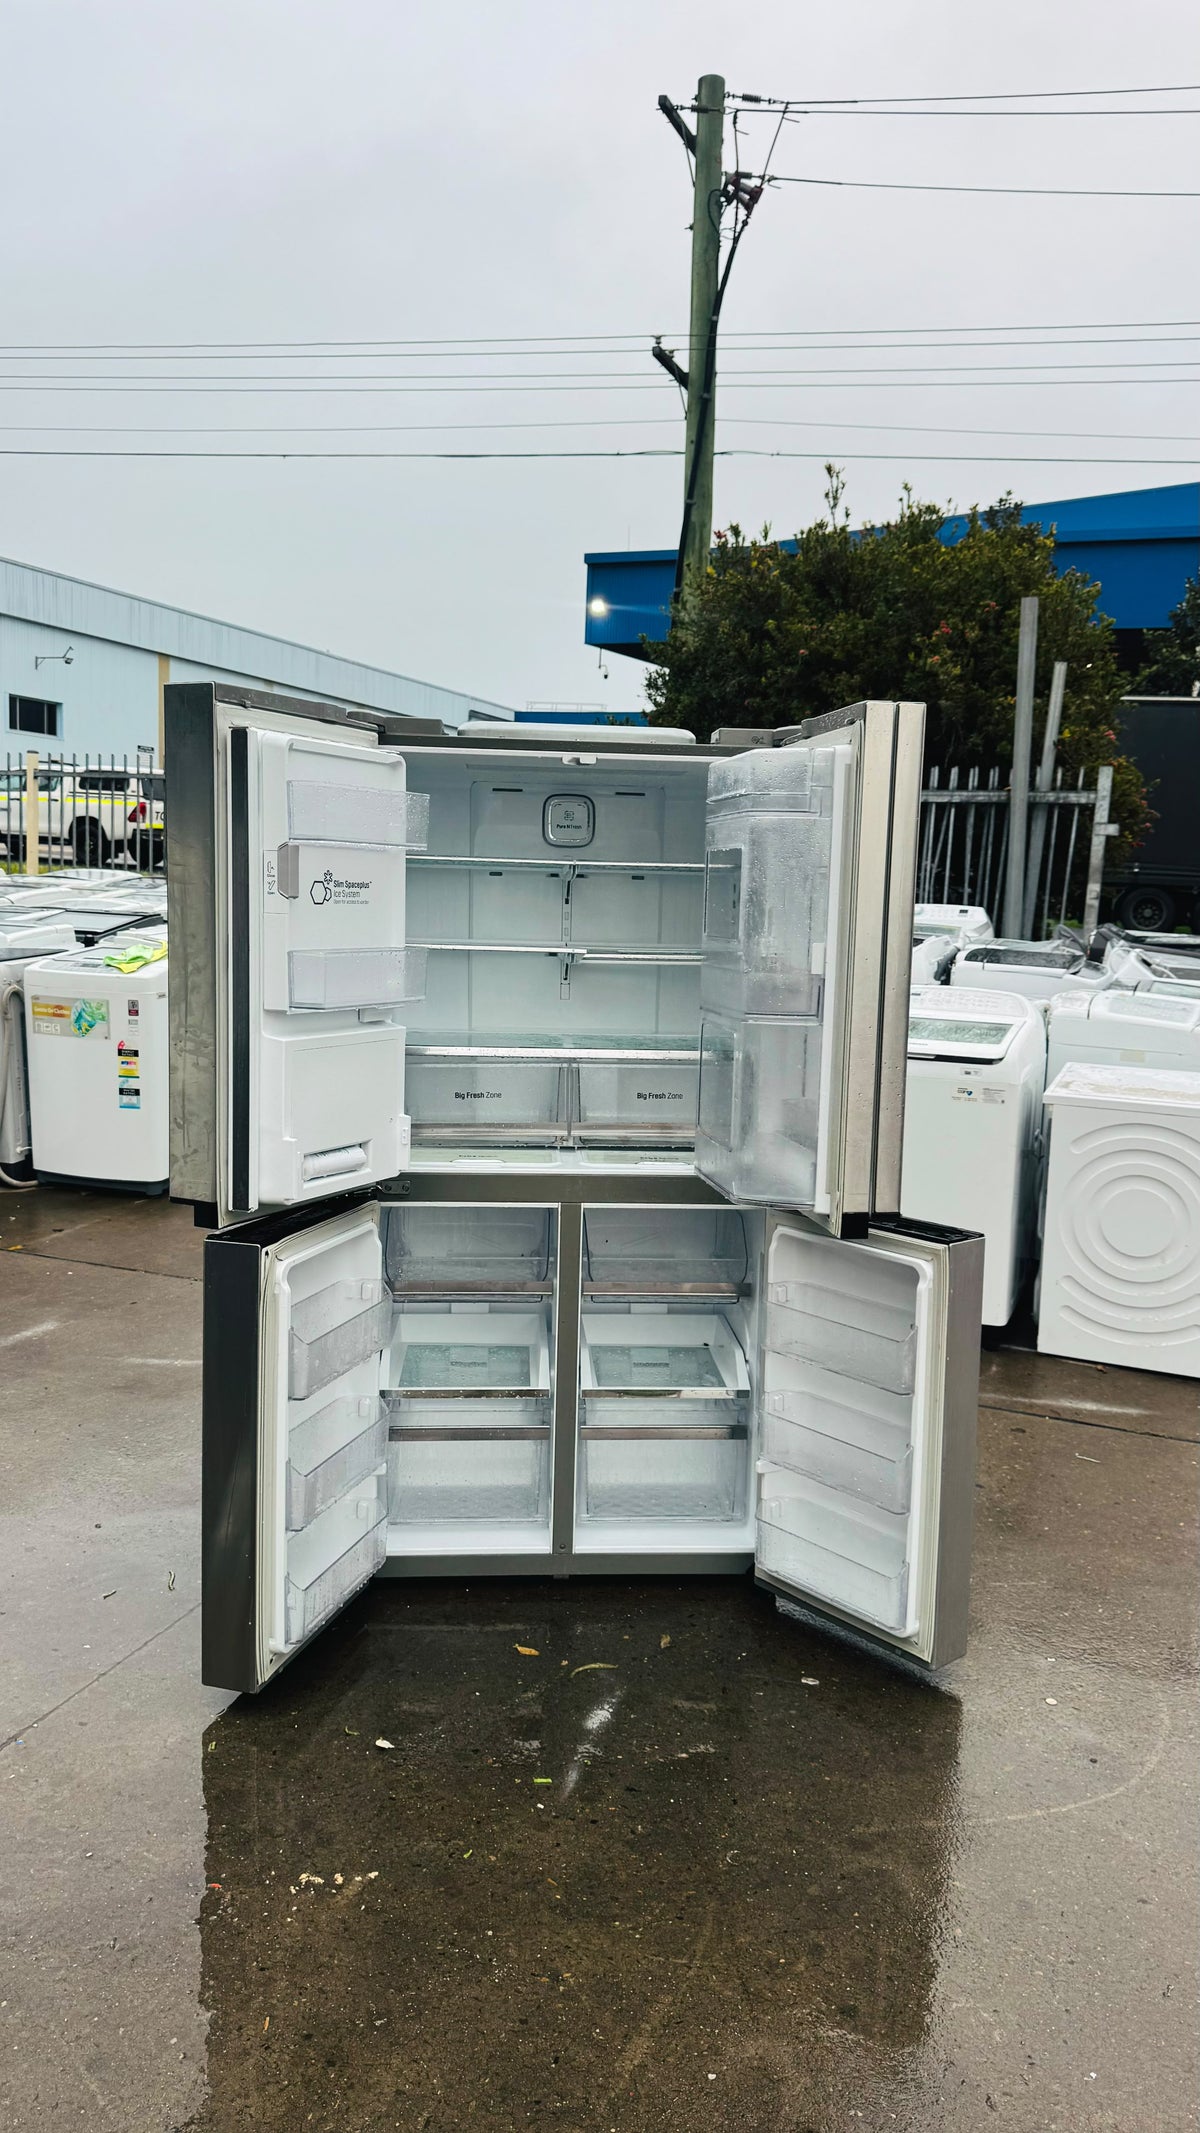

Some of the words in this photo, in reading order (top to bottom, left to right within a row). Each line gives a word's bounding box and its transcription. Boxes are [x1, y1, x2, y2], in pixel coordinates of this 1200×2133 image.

[333, 880, 345, 888] Slim
[333, 890, 341, 898] Ice
[342, 890, 361, 899] System
[454, 1091, 465, 1100] Big
[466, 1091, 485, 1099] Fresh
[485, 1091, 502, 1099] Zone
[636, 1092, 648, 1101] Big
[648, 1092, 666, 1100] Fresh
[667, 1092, 684, 1100] Zone
